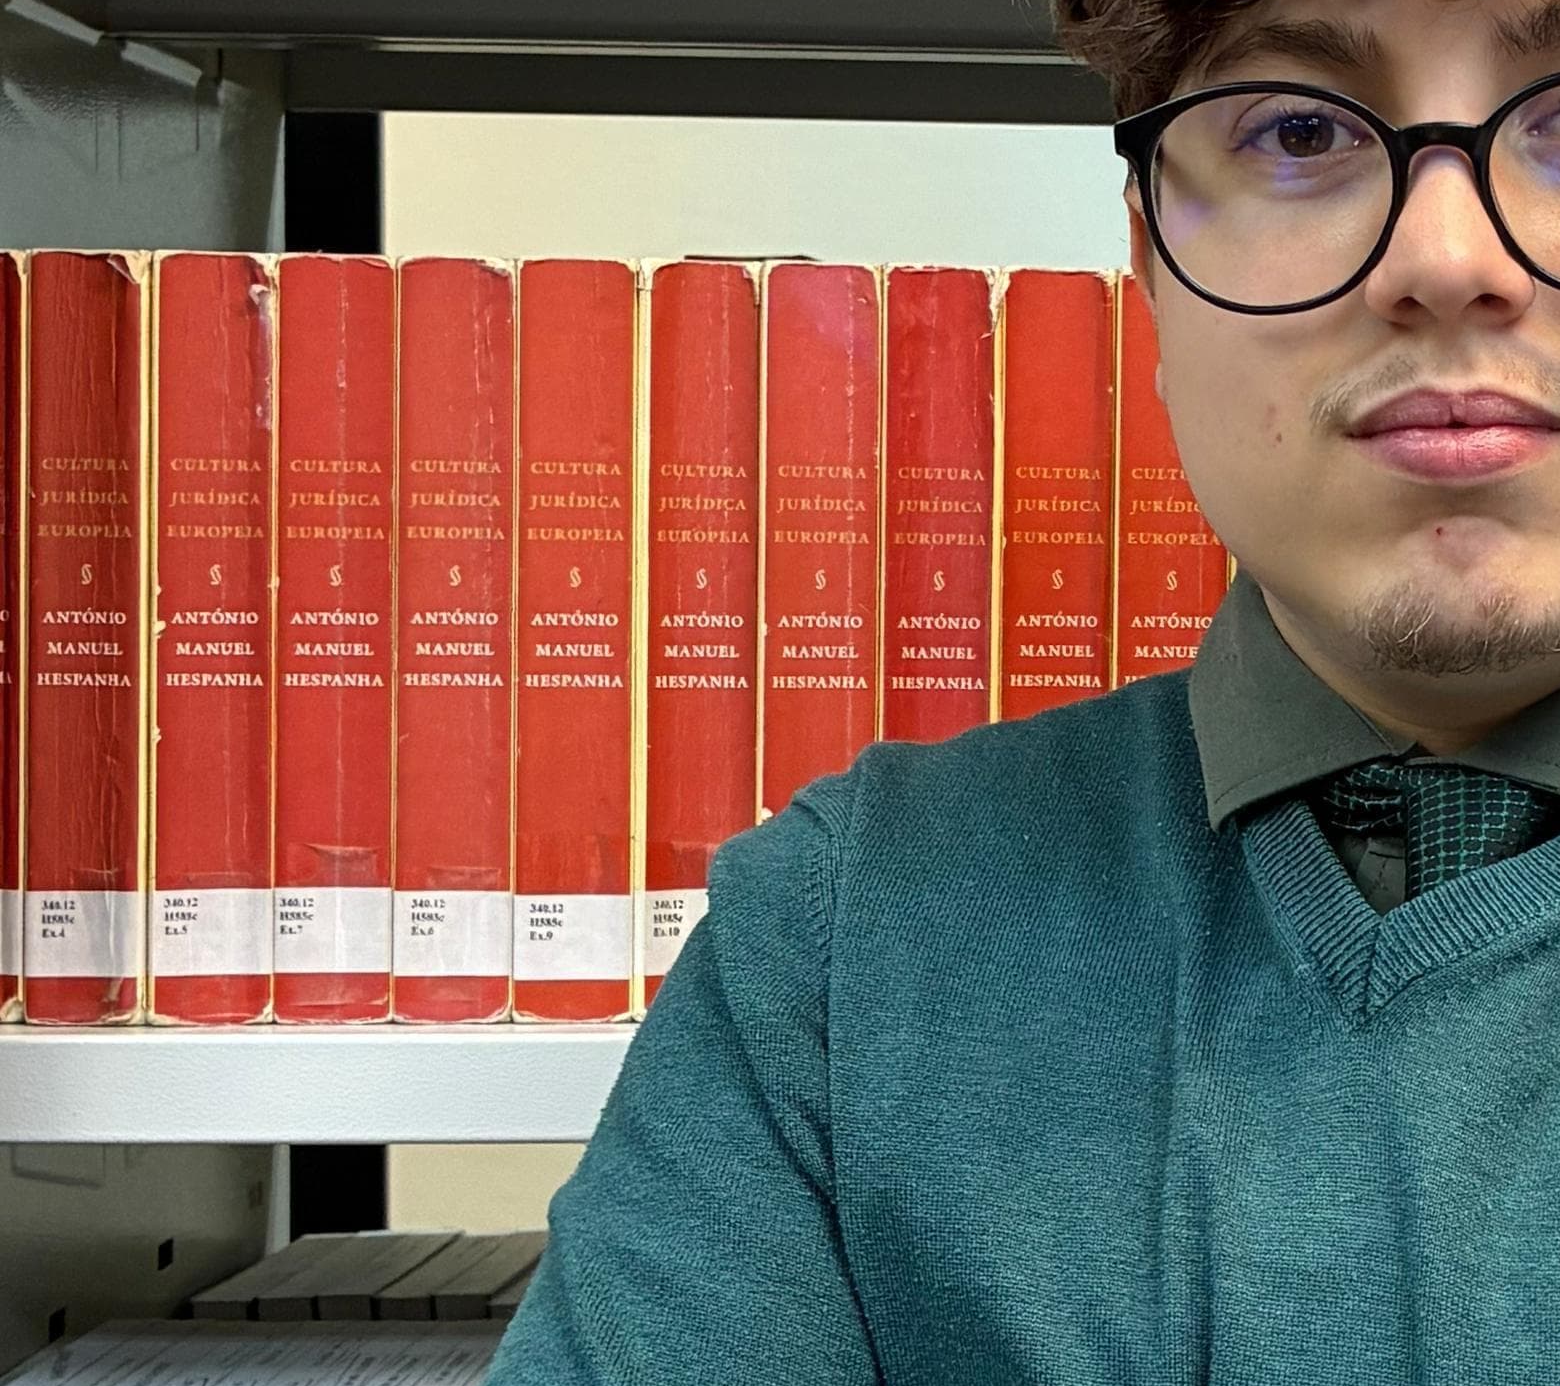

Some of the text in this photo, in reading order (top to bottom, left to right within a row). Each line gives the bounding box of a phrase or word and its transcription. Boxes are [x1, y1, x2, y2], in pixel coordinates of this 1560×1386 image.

[289, 459, 382, 474] CULTURA
[778, 465, 867, 480] CULTURA
[289, 489, 381, 510] JURÍDICA
[776, 492, 866, 514] JURÍDICA
[286, 526, 385, 541] EUROPEIA
[774, 530, 869, 545] EUROPEIA
[290, 607, 379, 626] ANTÓNIO
[777, 608, 863, 629] ANTÓNIO
[294, 642, 375, 656] MANUEL
[782, 641, 859, 659] MANUEL
[285, 673, 384, 687] HESPANHA
[772, 675, 868, 689] HESPANHA
